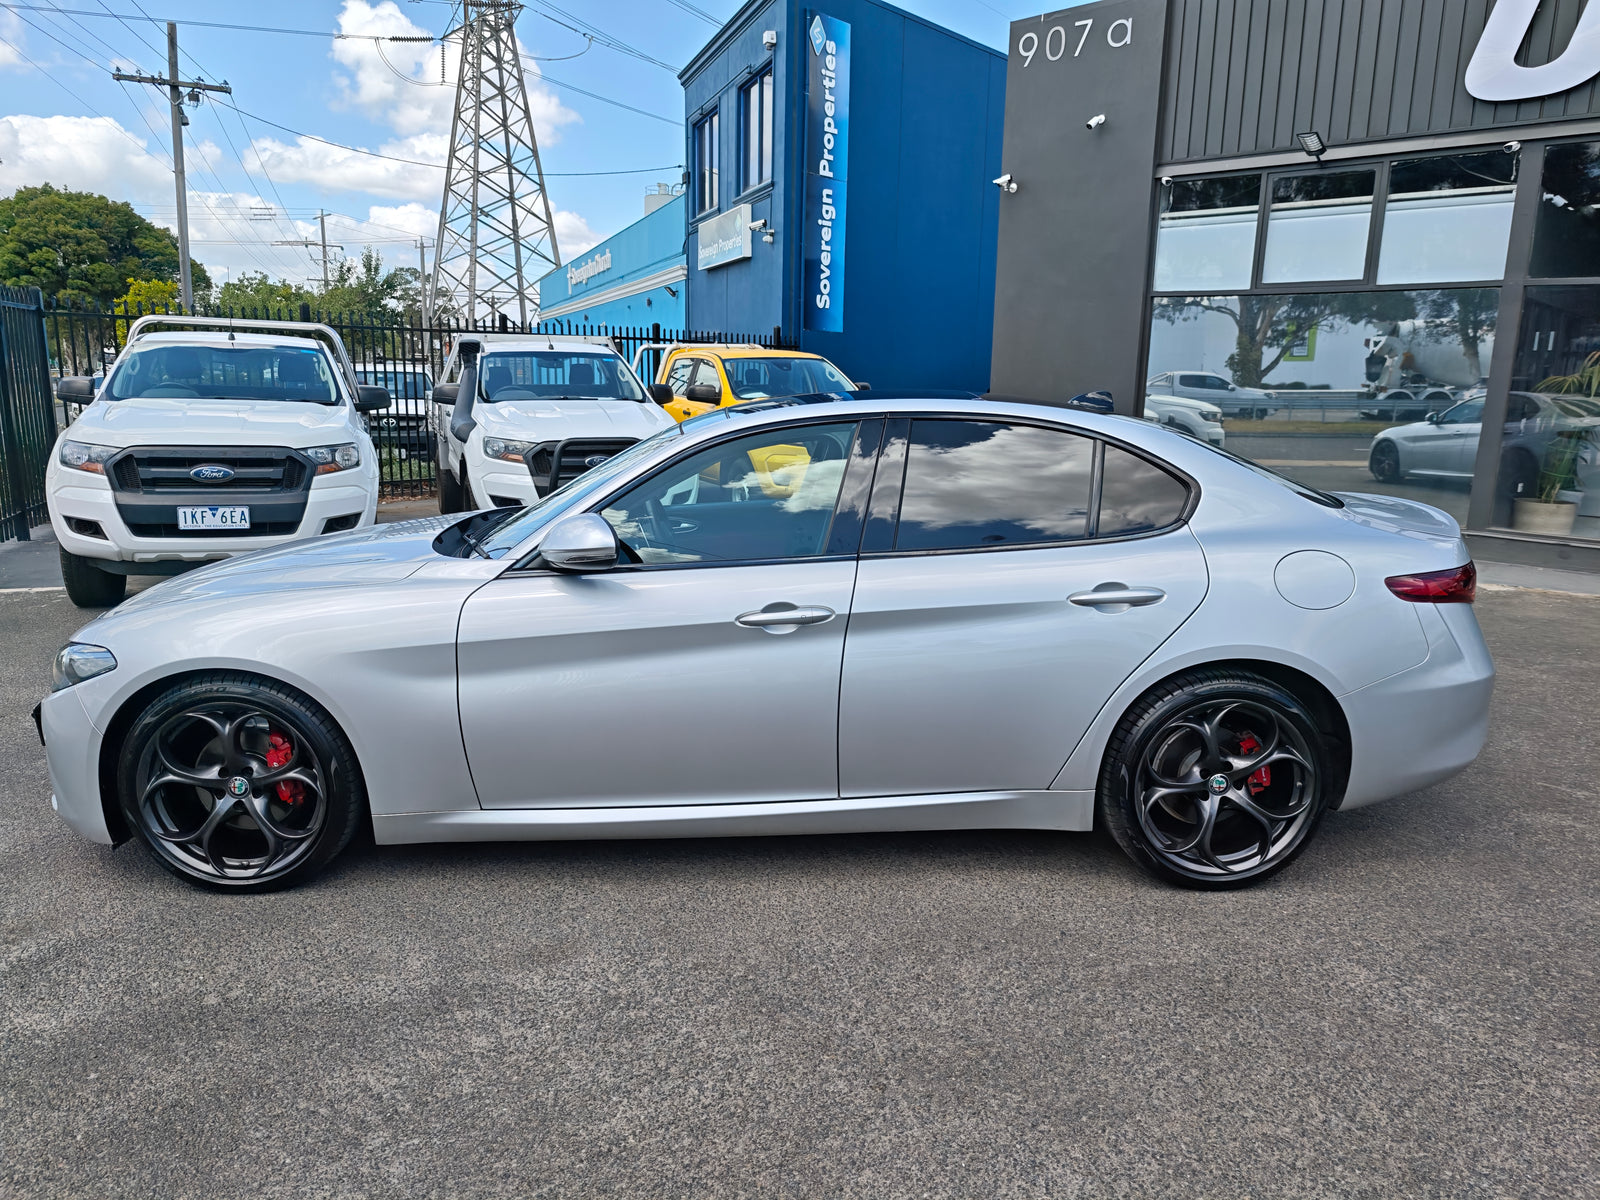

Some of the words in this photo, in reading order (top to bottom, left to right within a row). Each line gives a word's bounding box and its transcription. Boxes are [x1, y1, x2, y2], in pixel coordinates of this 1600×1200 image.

[1018, 18, 1093, 68] 907
[1106, 17, 1133, 48] a
[819, 39, 838, 178] Properties
[816, 188, 836, 309] Sovereign
[200, 468, 224, 478] Ford
[182, 510, 207, 524] 1KF
[220, 510, 247, 524] 6EA
